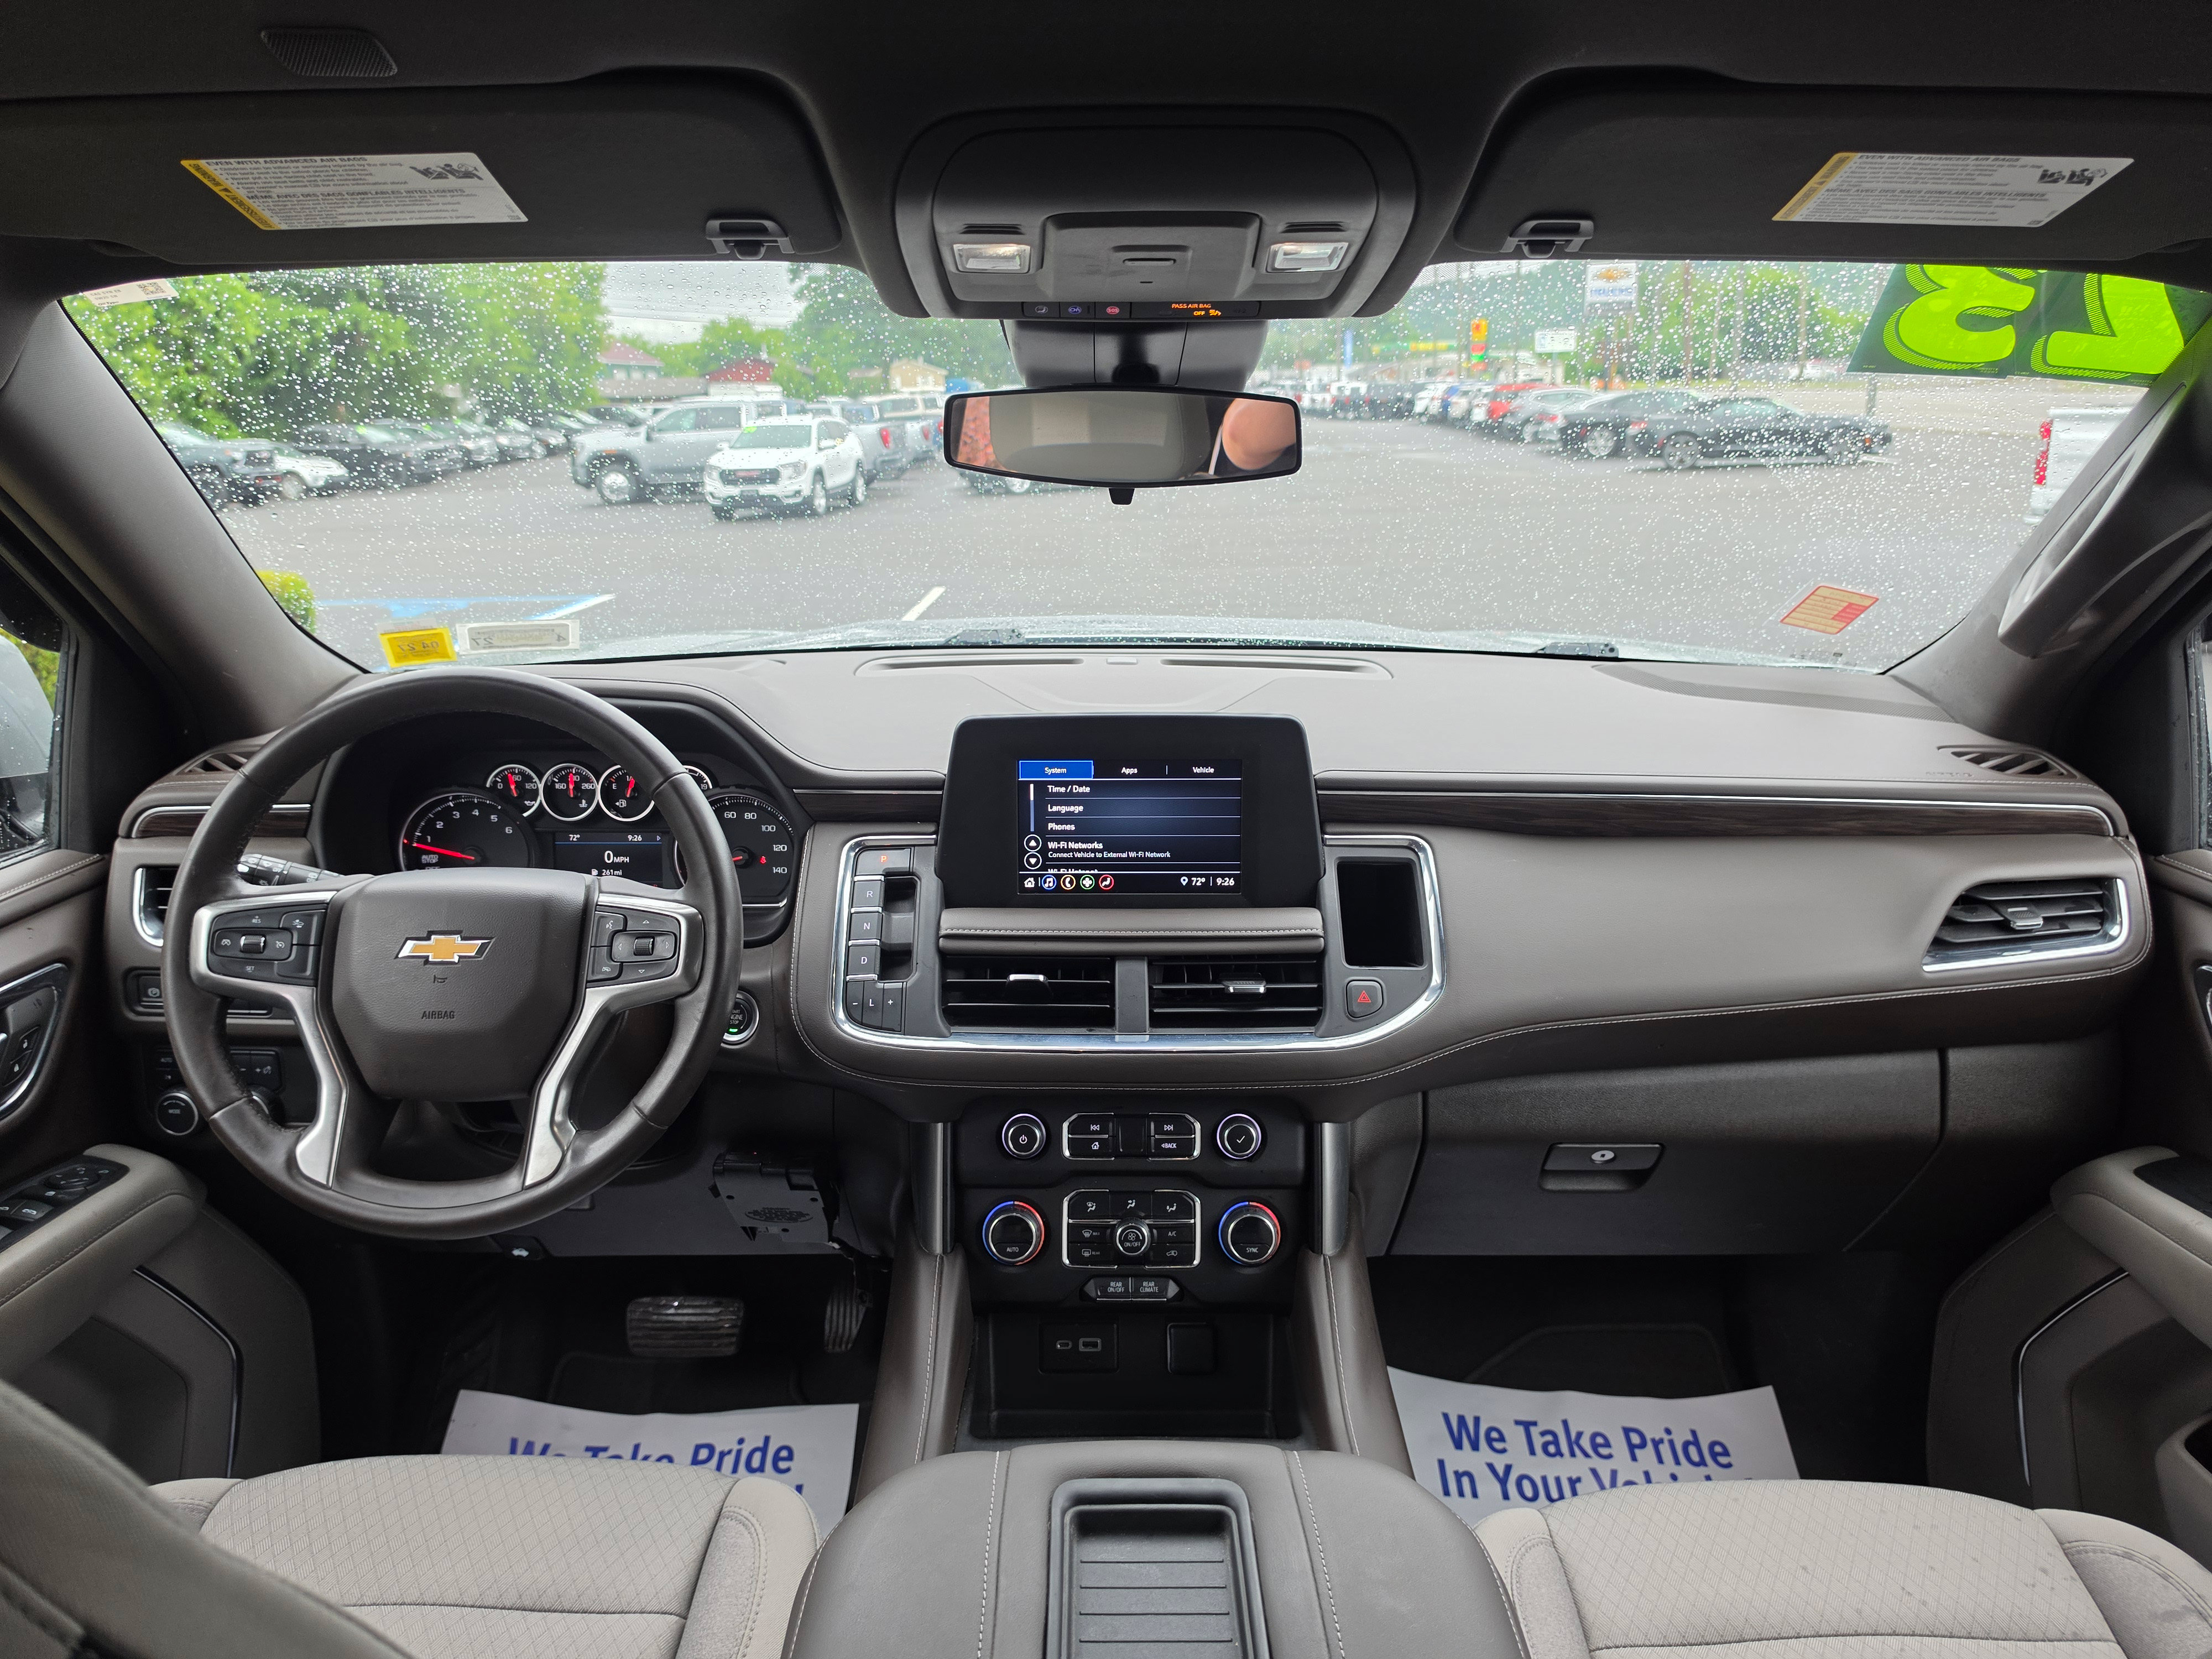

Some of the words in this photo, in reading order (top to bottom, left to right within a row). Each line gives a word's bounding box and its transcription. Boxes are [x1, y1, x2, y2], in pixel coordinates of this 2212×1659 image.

[1047, 804, 1084, 813] Language
[604, 850, 613, 863] 0
[1191, 877, 1206, 885] 72°
[1216, 878, 1235, 886] 9:26
[860, 956, 868, 964] D
[869, 998, 874, 1006] L
[421, 1010, 456, 1020] AIRBAG
[1441, 1411, 1506, 1454] We
[1514, 1418, 1614, 1460] Take
[1621, 1426, 1734, 1469] Pride
[691, 1434, 795, 1476] Pride
[1437, 1458, 1479, 1500] In
[1485, 1462, 1583, 1504] Your
